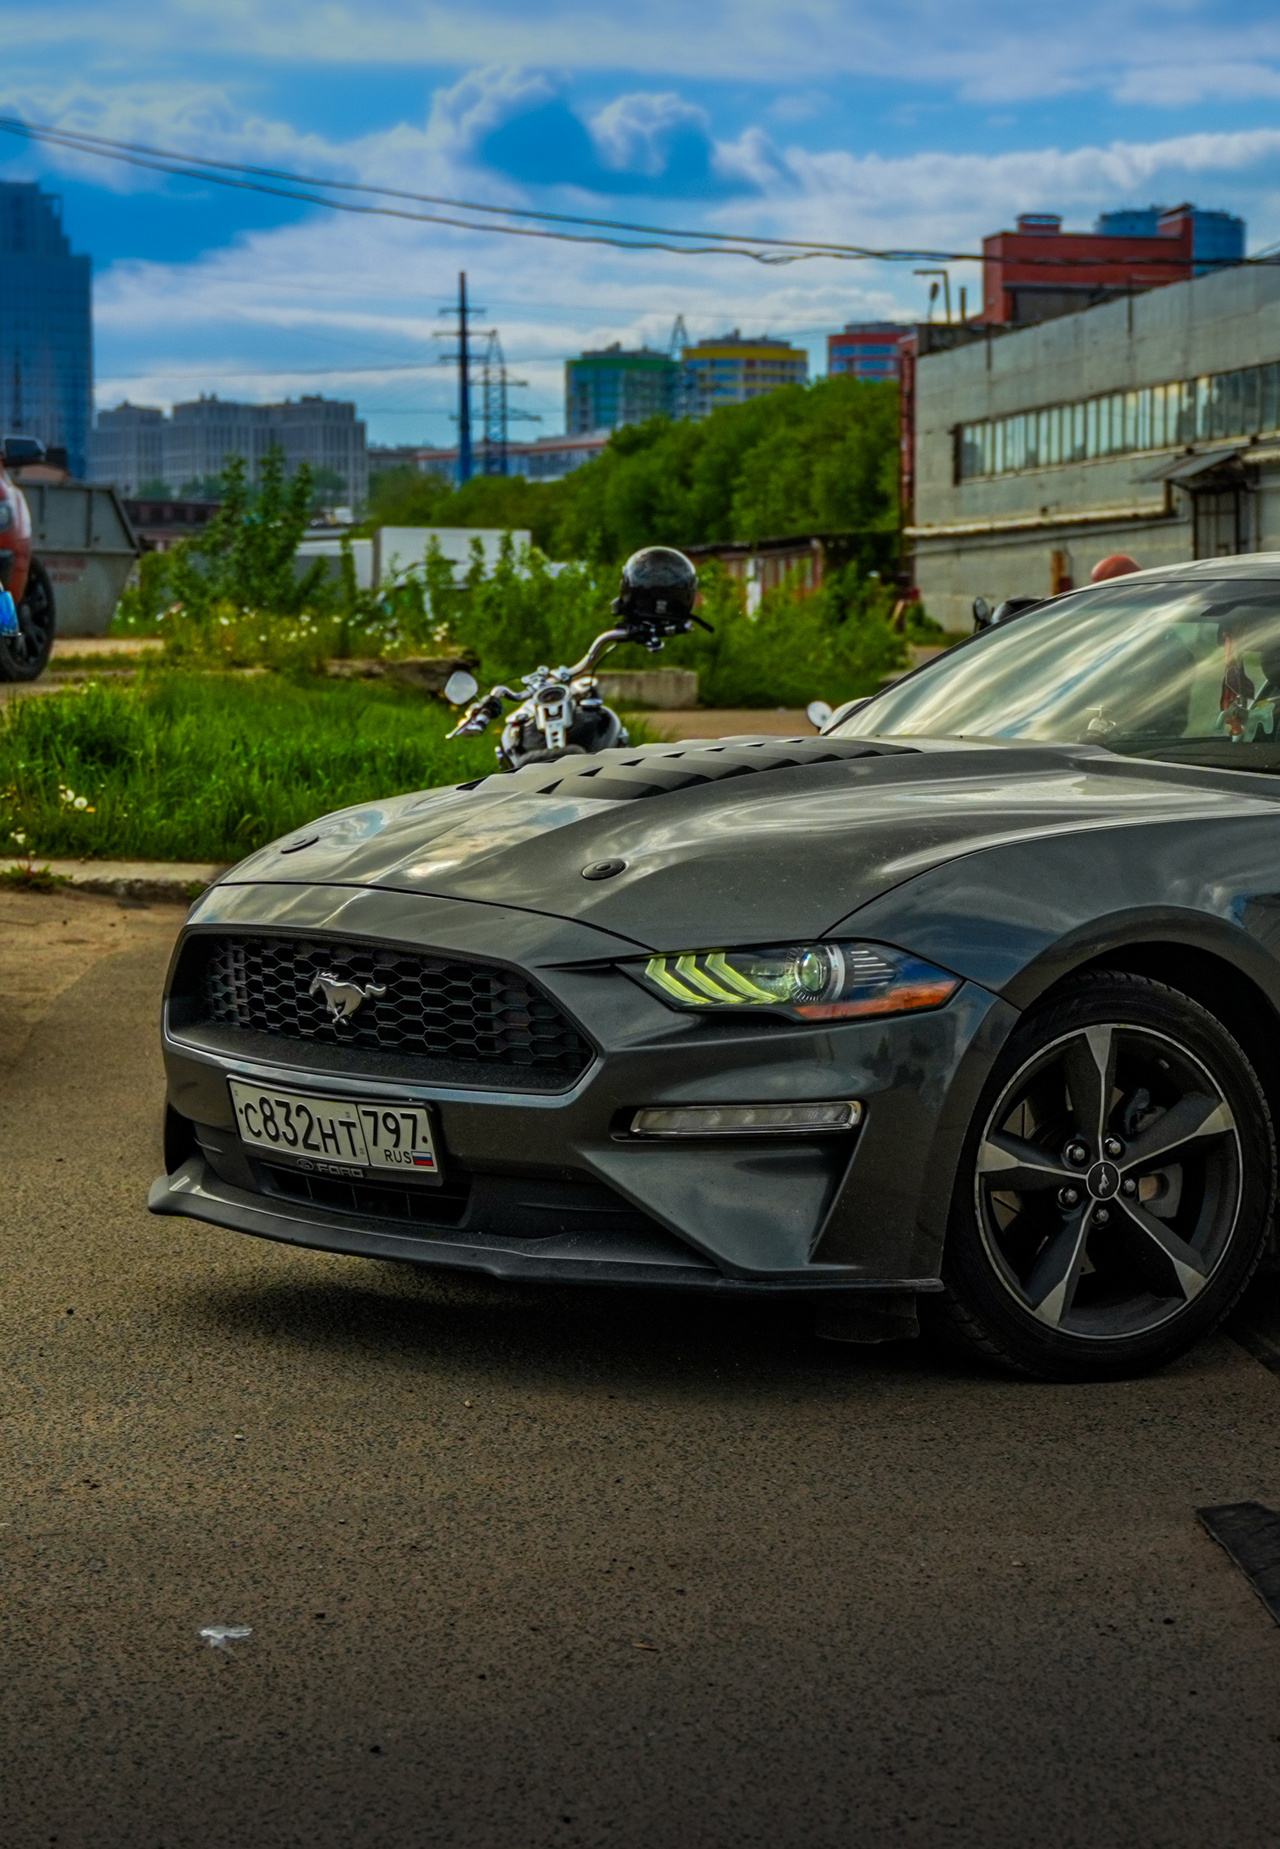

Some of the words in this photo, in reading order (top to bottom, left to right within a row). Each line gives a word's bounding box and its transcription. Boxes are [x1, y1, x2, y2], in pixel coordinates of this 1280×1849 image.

[362, 1110, 418, 1150] 797
[384, 1149, 412, 1165] RUS
[317, 1163, 364, 1178] FORD
